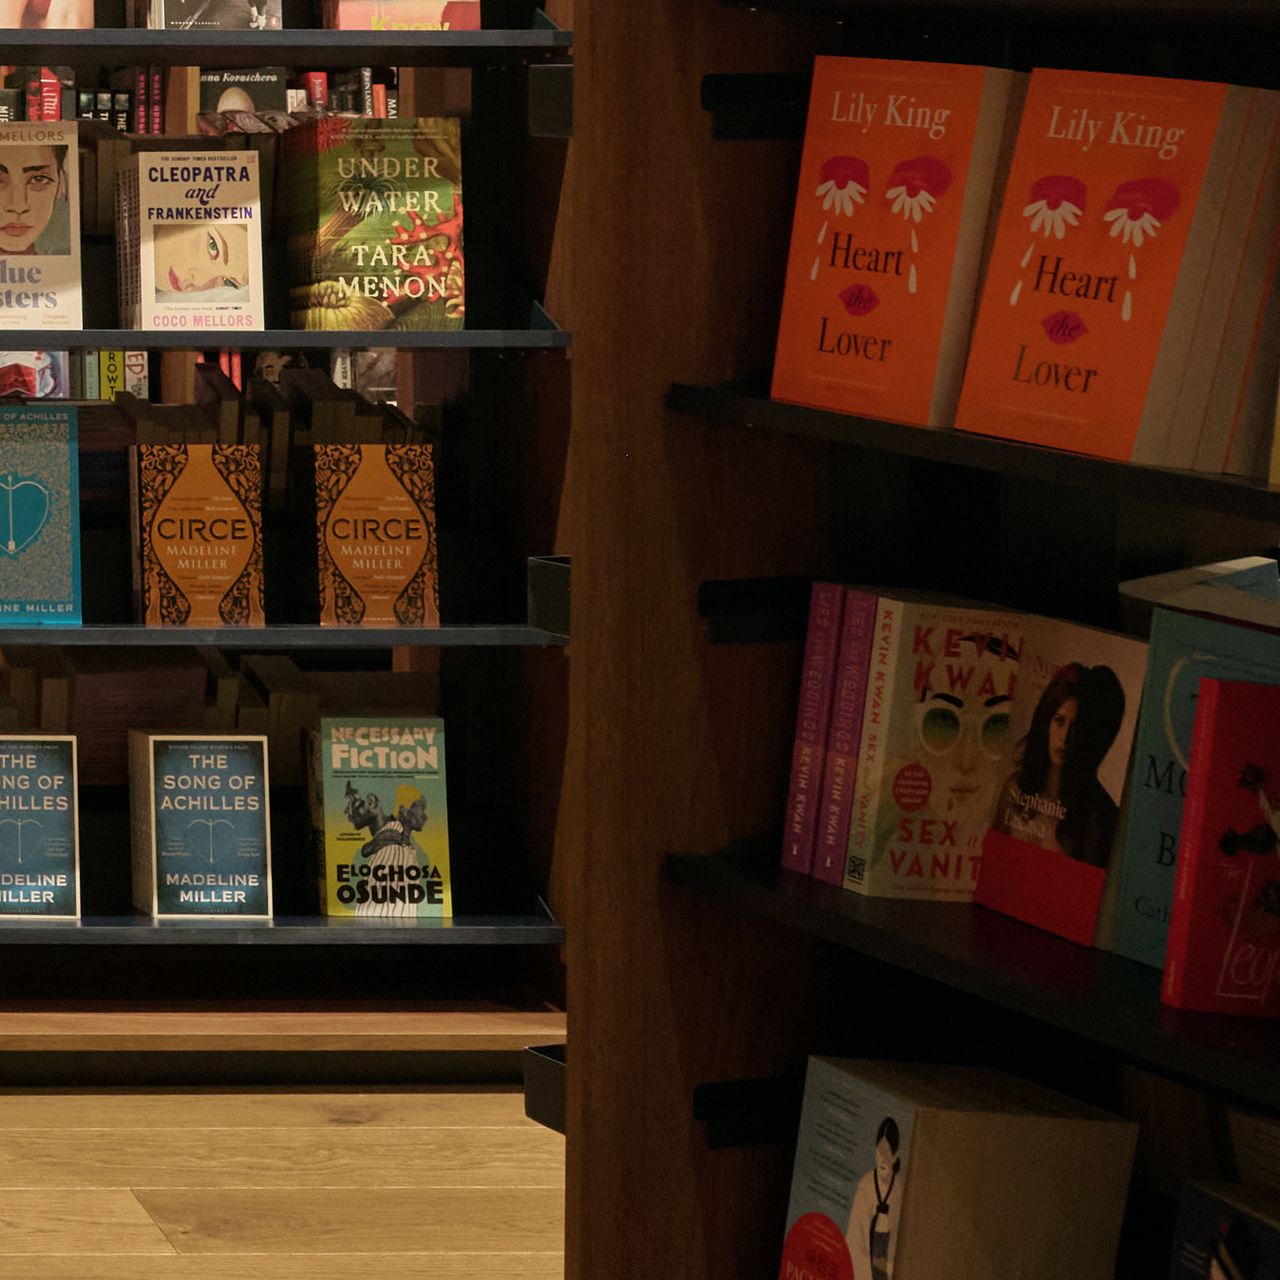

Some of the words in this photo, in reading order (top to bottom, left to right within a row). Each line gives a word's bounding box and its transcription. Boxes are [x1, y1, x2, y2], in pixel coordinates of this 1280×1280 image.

[830, 90, 879, 135] Lily
[883, 93, 951, 140] King
[0, 130, 66, 142] MELLORS
[1046, 105, 1104, 153] Lily
[1107, 110, 1186, 161] King
[148, 166, 251, 183] CLEOPATRA
[337, 156, 441, 179] UNDER
[185, 183, 220, 206] and
[339, 190, 443, 213] WATER
[147, 206, 253, 220] FRANKENSTEIN
[351, 244, 433, 267] TARA
[828, 231, 905, 278] Heart
[338, 275, 447, 298] MENON
[1032, 254, 1119, 303] Heart
[152, 315, 187, 328] COCO
[192, 315, 254, 328] MELLORS
[1048, 315, 1081, 339] the
[816, 316, 893, 363] Lover
[1010, 343, 1098, 394] Lover
[3, 413, 18, 421] OF
[21, 412, 70, 421] ACHILLES
[157, 518, 250, 542] CIRCE
[332, 518, 422, 542] CIRCE
[166, 545, 238, 557] MADELINE
[340, 545, 412, 556] MADELINE
[177, 559, 229, 570] MILLER
[351, 559, 403, 570] MILLER
[25, 603, 74, 613] MILLER
[330, 726, 438, 747] NECESSARY
[188, 753, 230, 770] THE
[331, 743, 439, 770] FICTION
[37, 774, 66, 791] OF
[162, 774, 222, 791] SONG
[228, 774, 257, 791] OF
[160, 794, 261, 811] ACHILLES
[1007, 785, 1070, 821] Stephanie
[898, 816, 958, 847] SEX
[165, 873, 261, 887] MADELINE
[335, 863, 443, 883] ELOGHOSA
[179, 889, 248, 904] MILLER
[336, 879, 445, 905] OSUNDE
